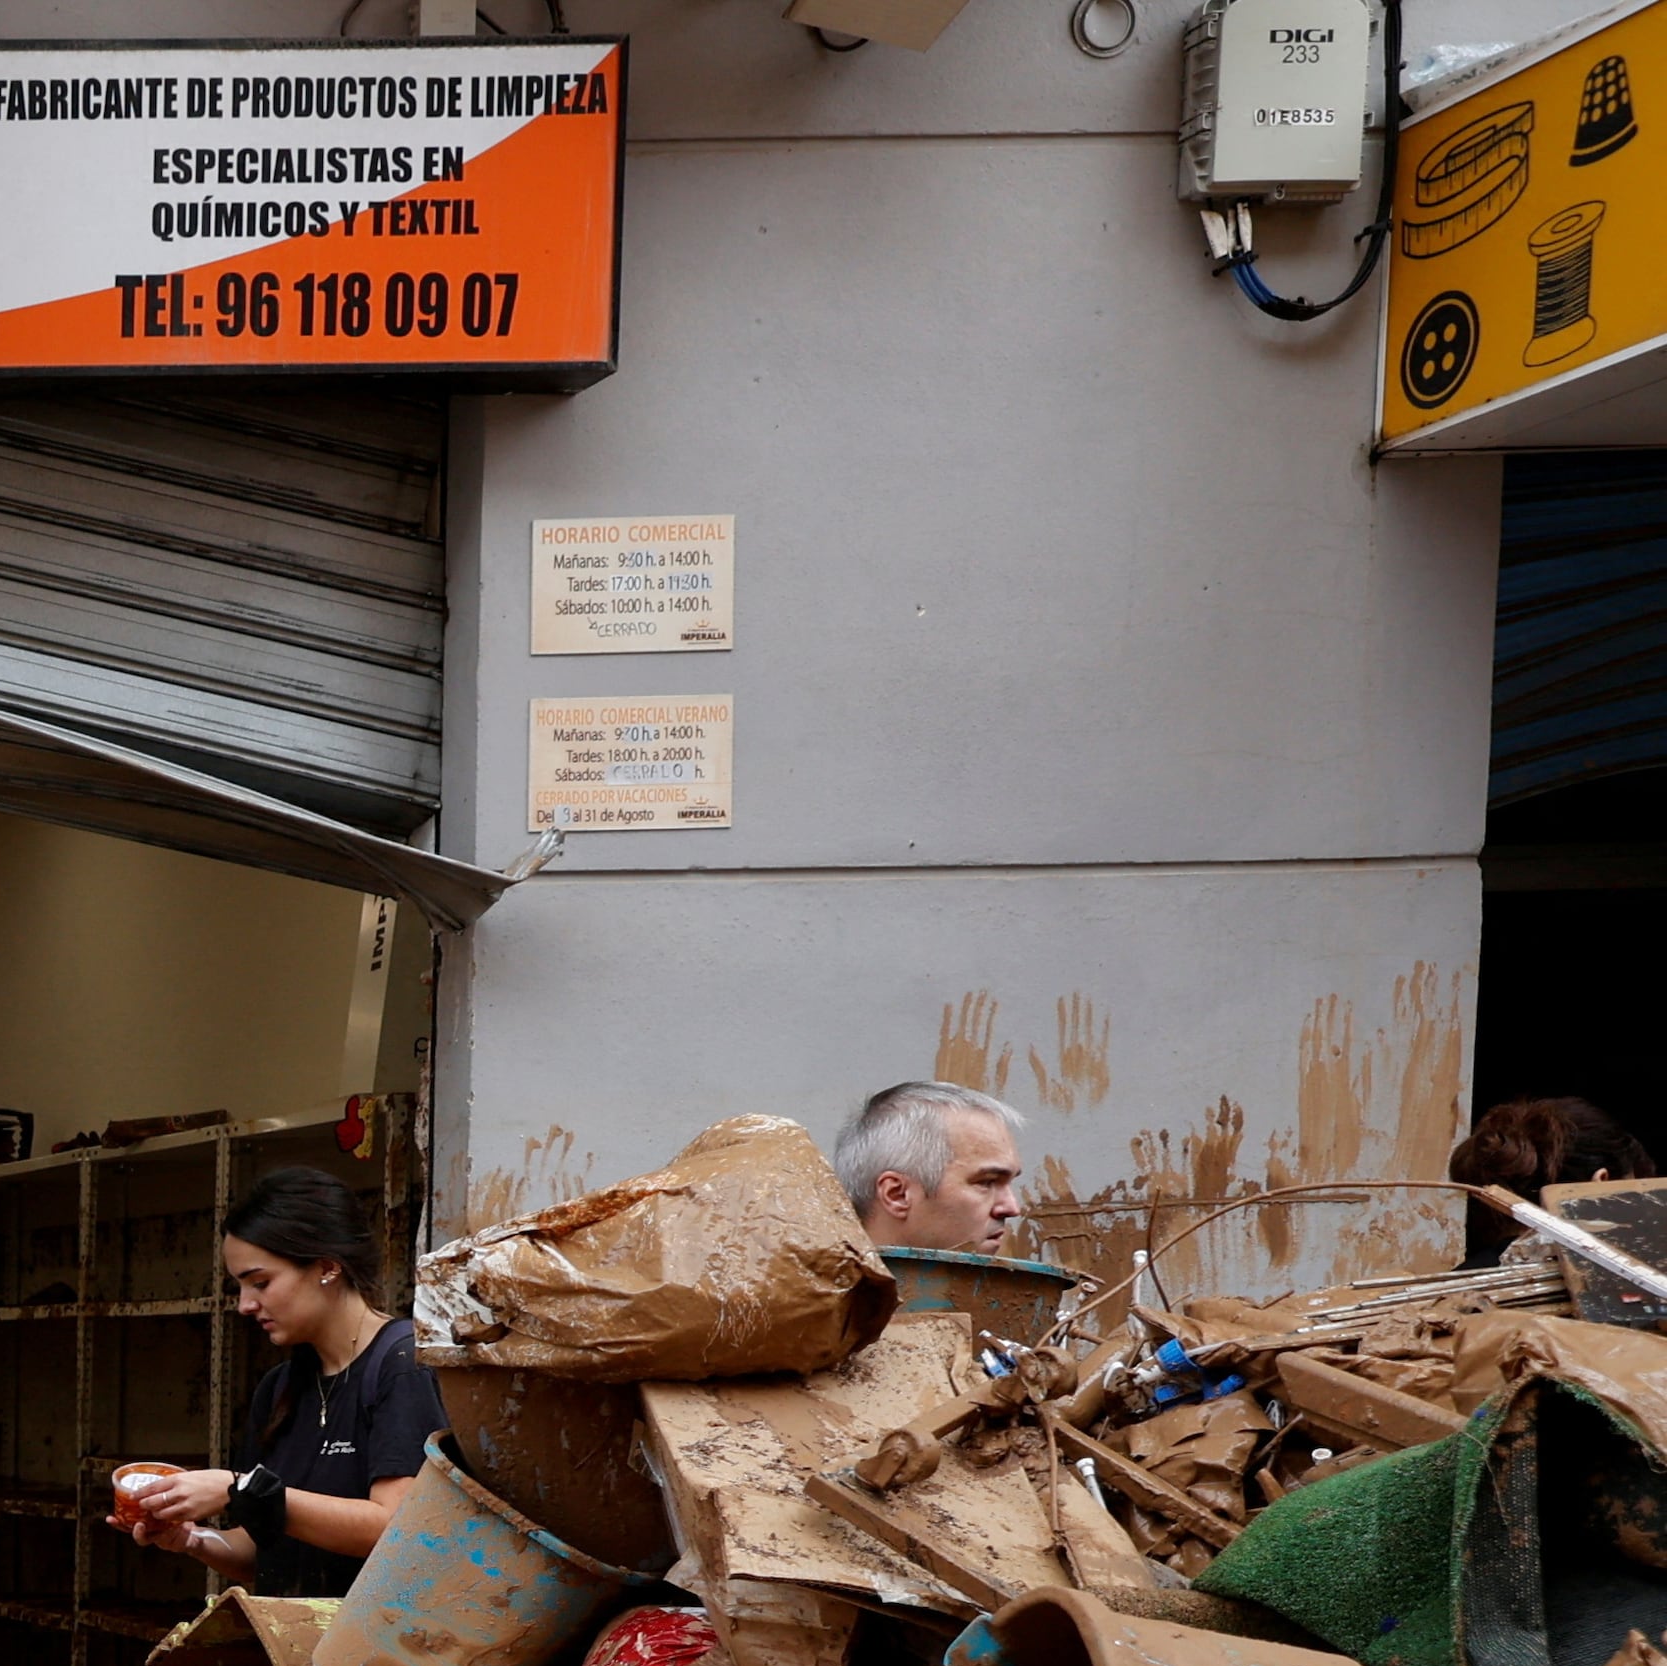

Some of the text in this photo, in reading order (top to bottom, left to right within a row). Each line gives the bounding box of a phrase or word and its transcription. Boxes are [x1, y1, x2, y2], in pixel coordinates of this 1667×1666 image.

[1270, 29, 1334, 43] DIGI
[1282, 45, 1320, 63] 233
[186, 78, 223, 119] DE
[232, 76, 417, 118] PRODUCTOS
[426, 76, 461, 117] DE
[470, 72, 608, 116] LIMPIEZA
[153, 146, 464, 184] ESPECIALISTAS EN
[151, 196, 480, 241] QUÍMICOS Y TEXTIL
[115, 272, 519, 338] TEL: 96 118 09 07
[542, 523, 726, 545] HORARIO COMERCIAL
[554, 553, 609, 569] Mañanas:
[645, 551, 656, 567] h.
[659, 556, 665, 566] a
[669, 551, 700, 566] 14:00
[703, 550, 713, 565] h.
[567, 577, 608, 592] Tardes:
[611, 575, 642, 591] 17:00
[645, 575, 655, 590] h.
[658, 579, 664, 589] a
[701, 573, 712, 589] h.
[555, 596, 712, 615] Sábados: 10:00 h. a 14:00 h.
[597, 622, 657, 637] CERRADO
[680, 631, 726, 641] IMPERALIA
[537, 705, 728, 726] HORARIO COMERCIAL VERANO
[554, 727, 606, 742] Mañanas:
[642, 726, 653, 741] h.
[653, 730, 660, 740] a
[664, 726, 693, 739] 14:00
[696, 725, 705, 738] h.
[566, 746, 704, 763] Tardes: 18:00 h. a 20:00 h.
[555, 768, 605, 782] Sábados:
[694, 765, 704, 778] h.
[536, 788, 688, 805] CERRADO POR VACACIONES
[537, 809, 554, 823] Del
[572, 809, 581, 822] al
[586, 808, 596, 821] 31
[600, 808, 613, 821] de
[617, 808, 654, 824] Agosto
[677, 810, 726, 819] IMPERALIA
